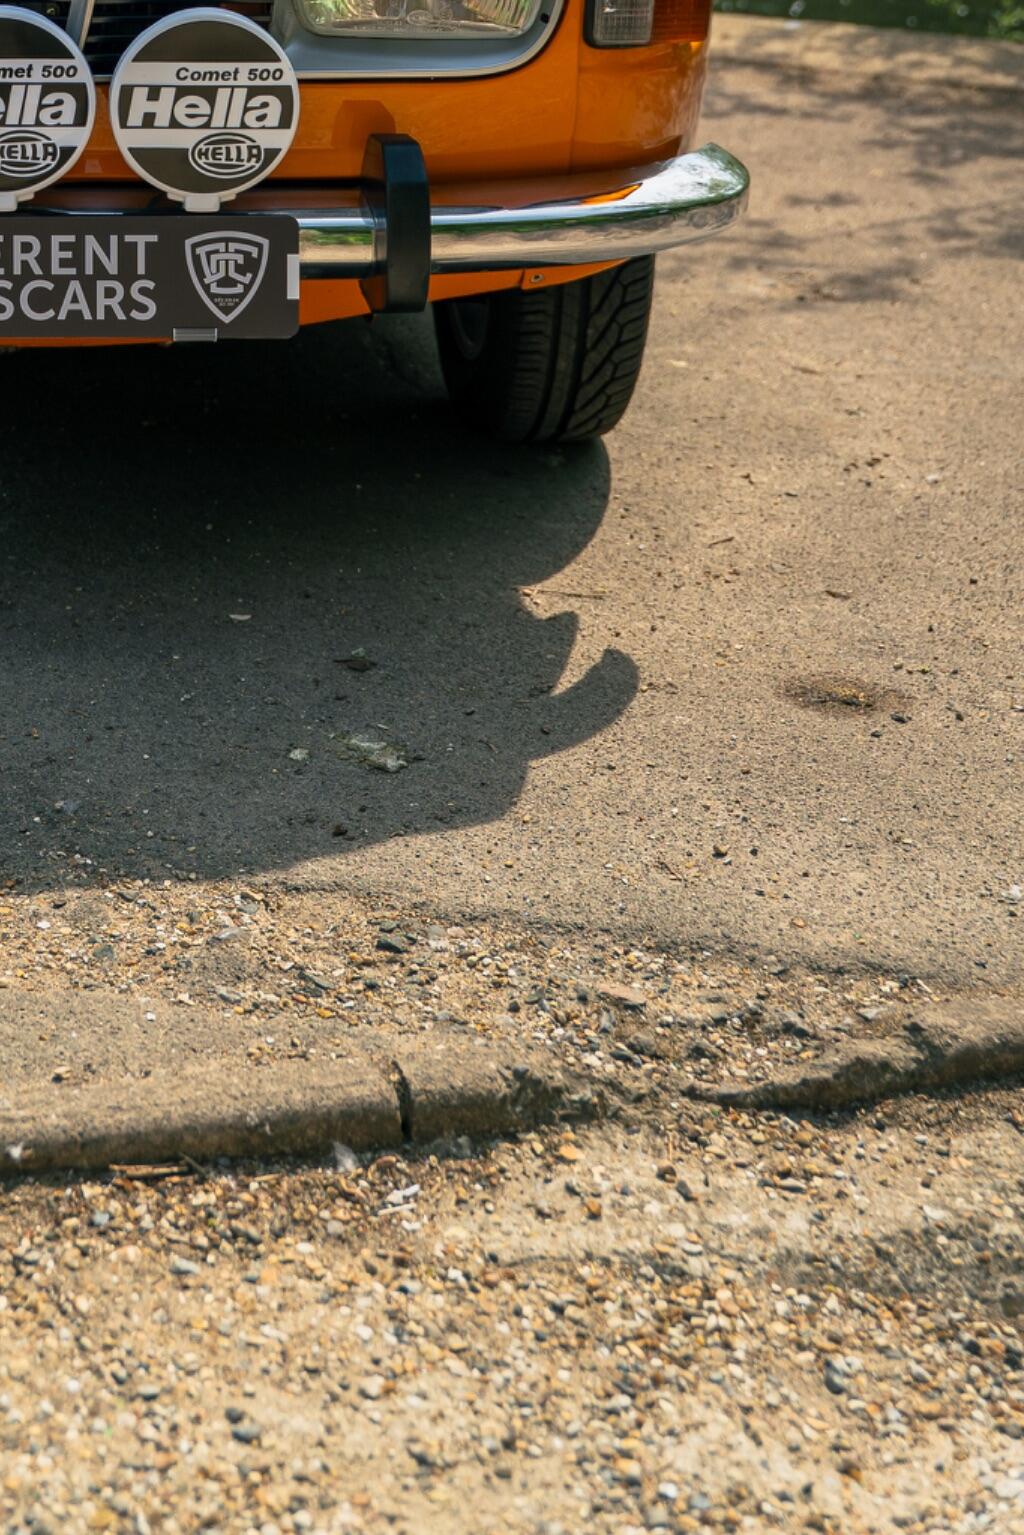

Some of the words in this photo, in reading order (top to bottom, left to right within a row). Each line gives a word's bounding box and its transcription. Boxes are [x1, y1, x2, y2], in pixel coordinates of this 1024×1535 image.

[41, 65, 78, 78] 500
[176, 67, 238, 81] Comet
[247, 68, 283, 81] 500
[126, 86, 282, 128] Hella
[197, 145, 262, 163] HELLA
